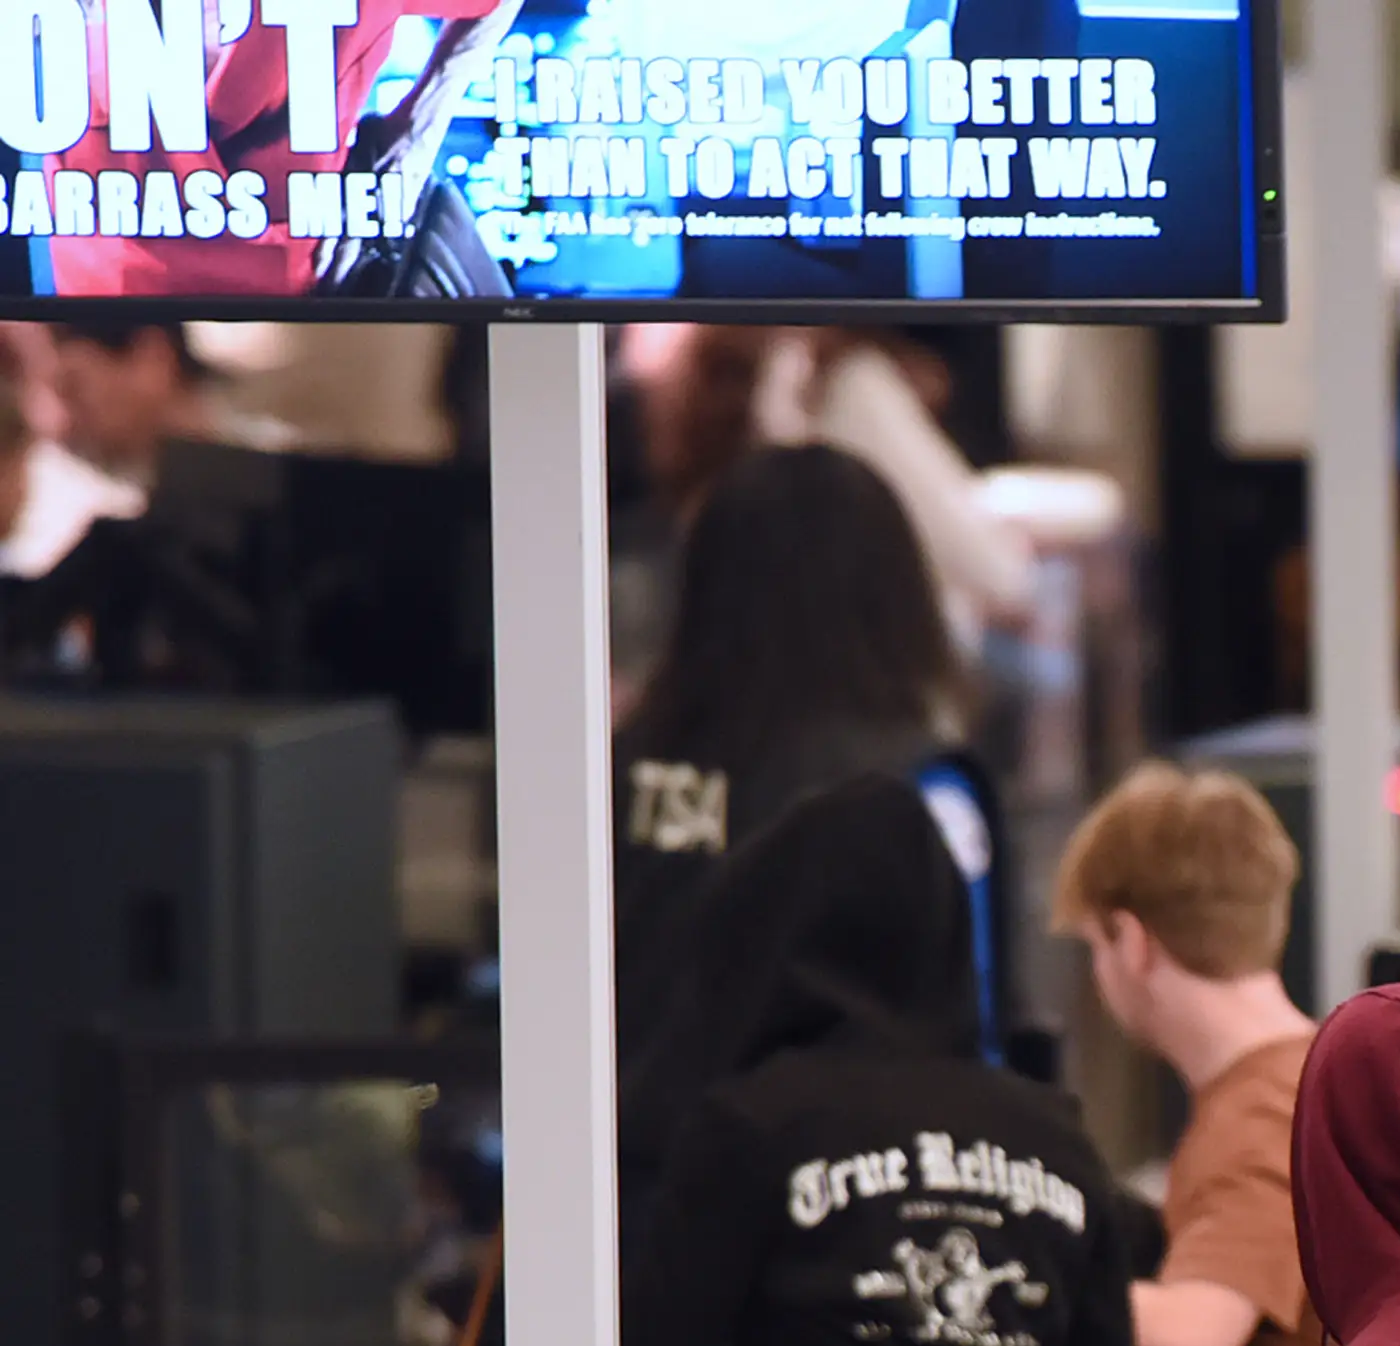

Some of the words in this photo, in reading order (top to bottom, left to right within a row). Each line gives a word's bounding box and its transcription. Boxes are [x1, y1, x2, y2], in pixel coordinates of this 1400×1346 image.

[536, 57, 764, 125] RAISED
[780, 57, 908, 126] YOU
[927, 58, 1157, 125] BETTER
[494, 136, 647, 198] THAN
[658, 136, 735, 199] TO
[747, 136, 861, 199] ACT
[872, 137, 1018, 198] THAT
[1028, 137, 1167, 198] WAY.
[0, 169, 269, 240] ARRASS
[544, 212, 588, 236] FAA
[864, 211, 966, 242] following
[629, 760, 728, 852] TSA
[788, 1148, 909, 1229] True
[915, 1130, 1086, 1235] Religion
